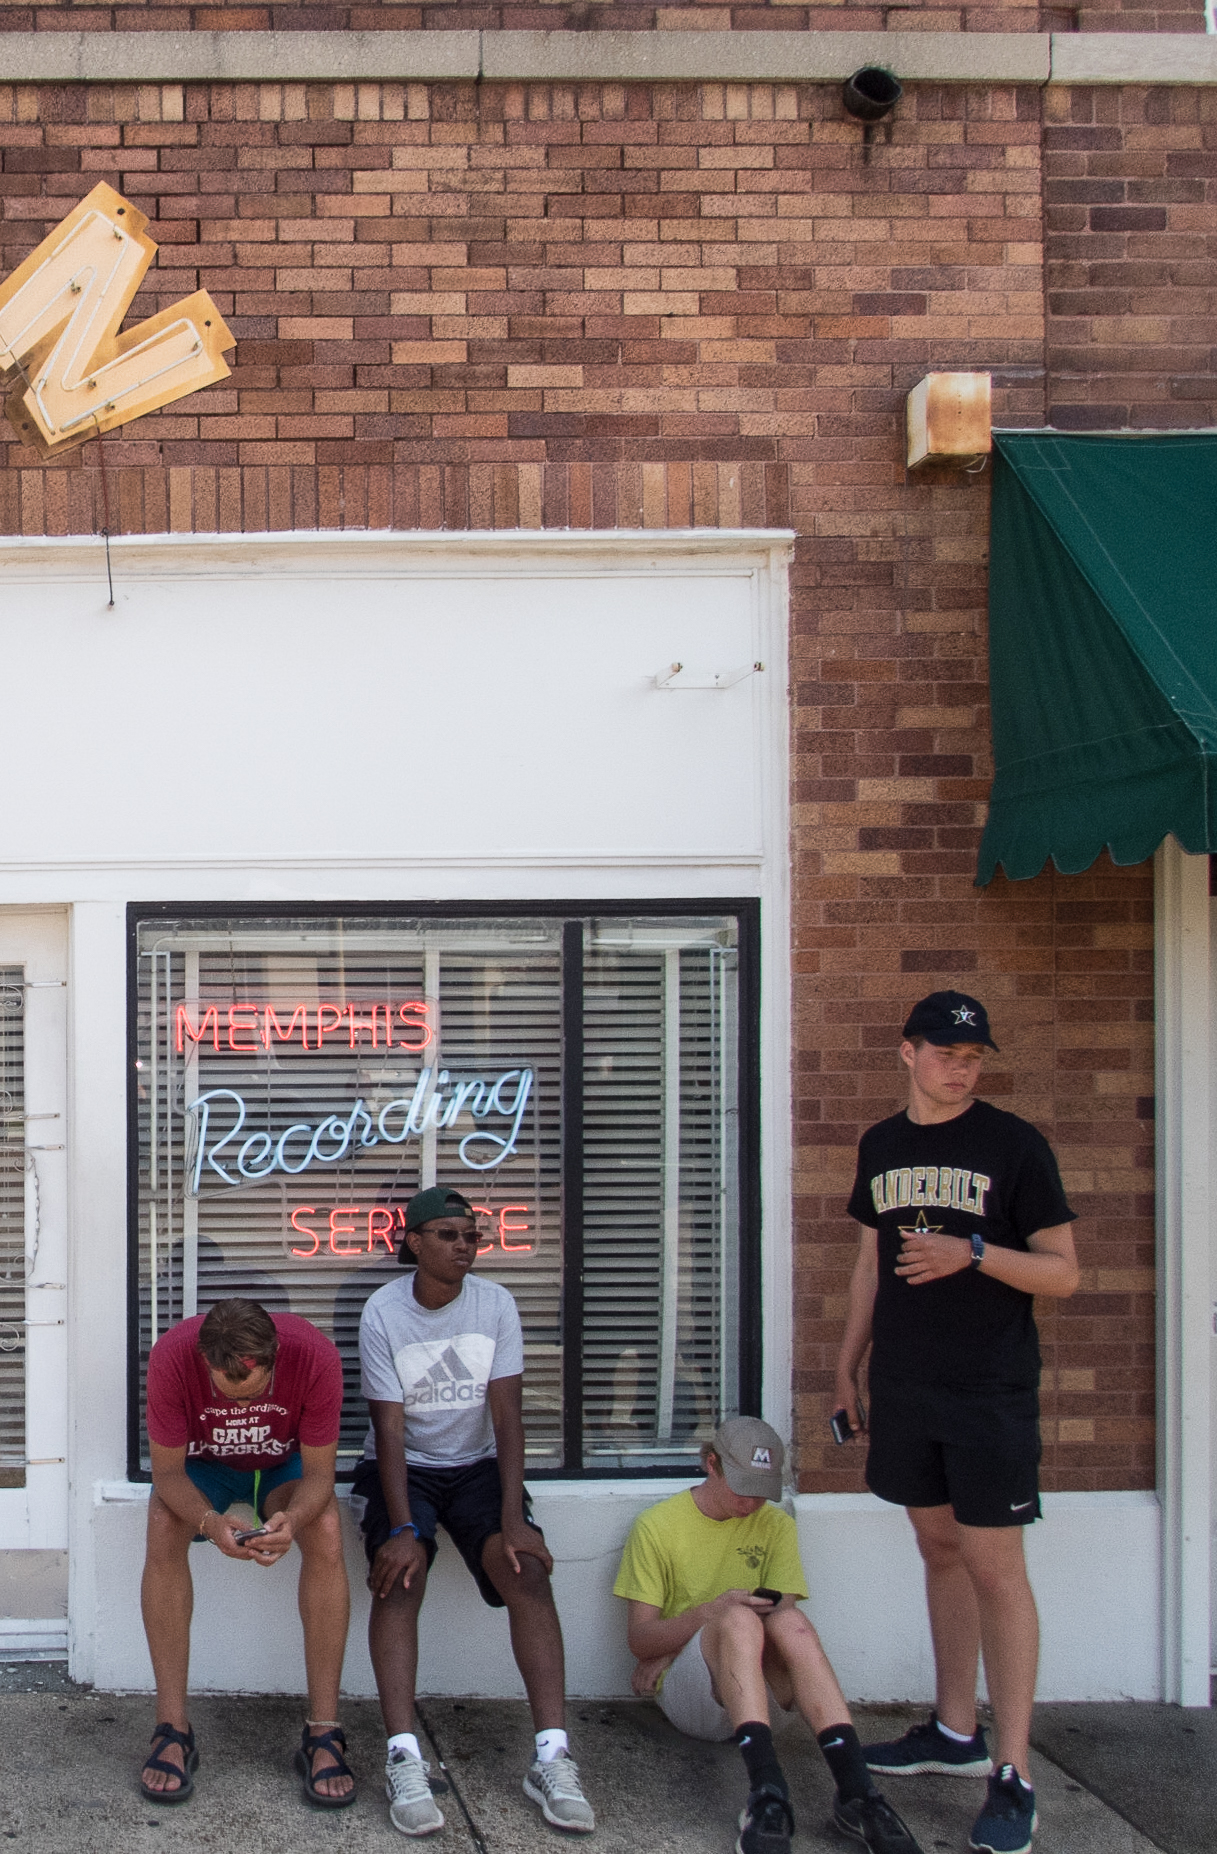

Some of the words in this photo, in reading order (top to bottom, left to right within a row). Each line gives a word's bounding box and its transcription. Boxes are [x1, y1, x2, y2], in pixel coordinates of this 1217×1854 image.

[175, 1001, 434, 1052] MEMPHIS
[188, 1067, 534, 1195] Recording
[871, 1166, 991, 1217] ANDERBILT
[404, 1379, 486, 1407] adidas
[199, 1406, 228, 1421] ecape
[230, 1406, 247, 1416] the
[225, 1418, 247, 1426] WORK
[248, 1416, 260, 1424] AT
[212, 1425, 271, 1444] CAMP
